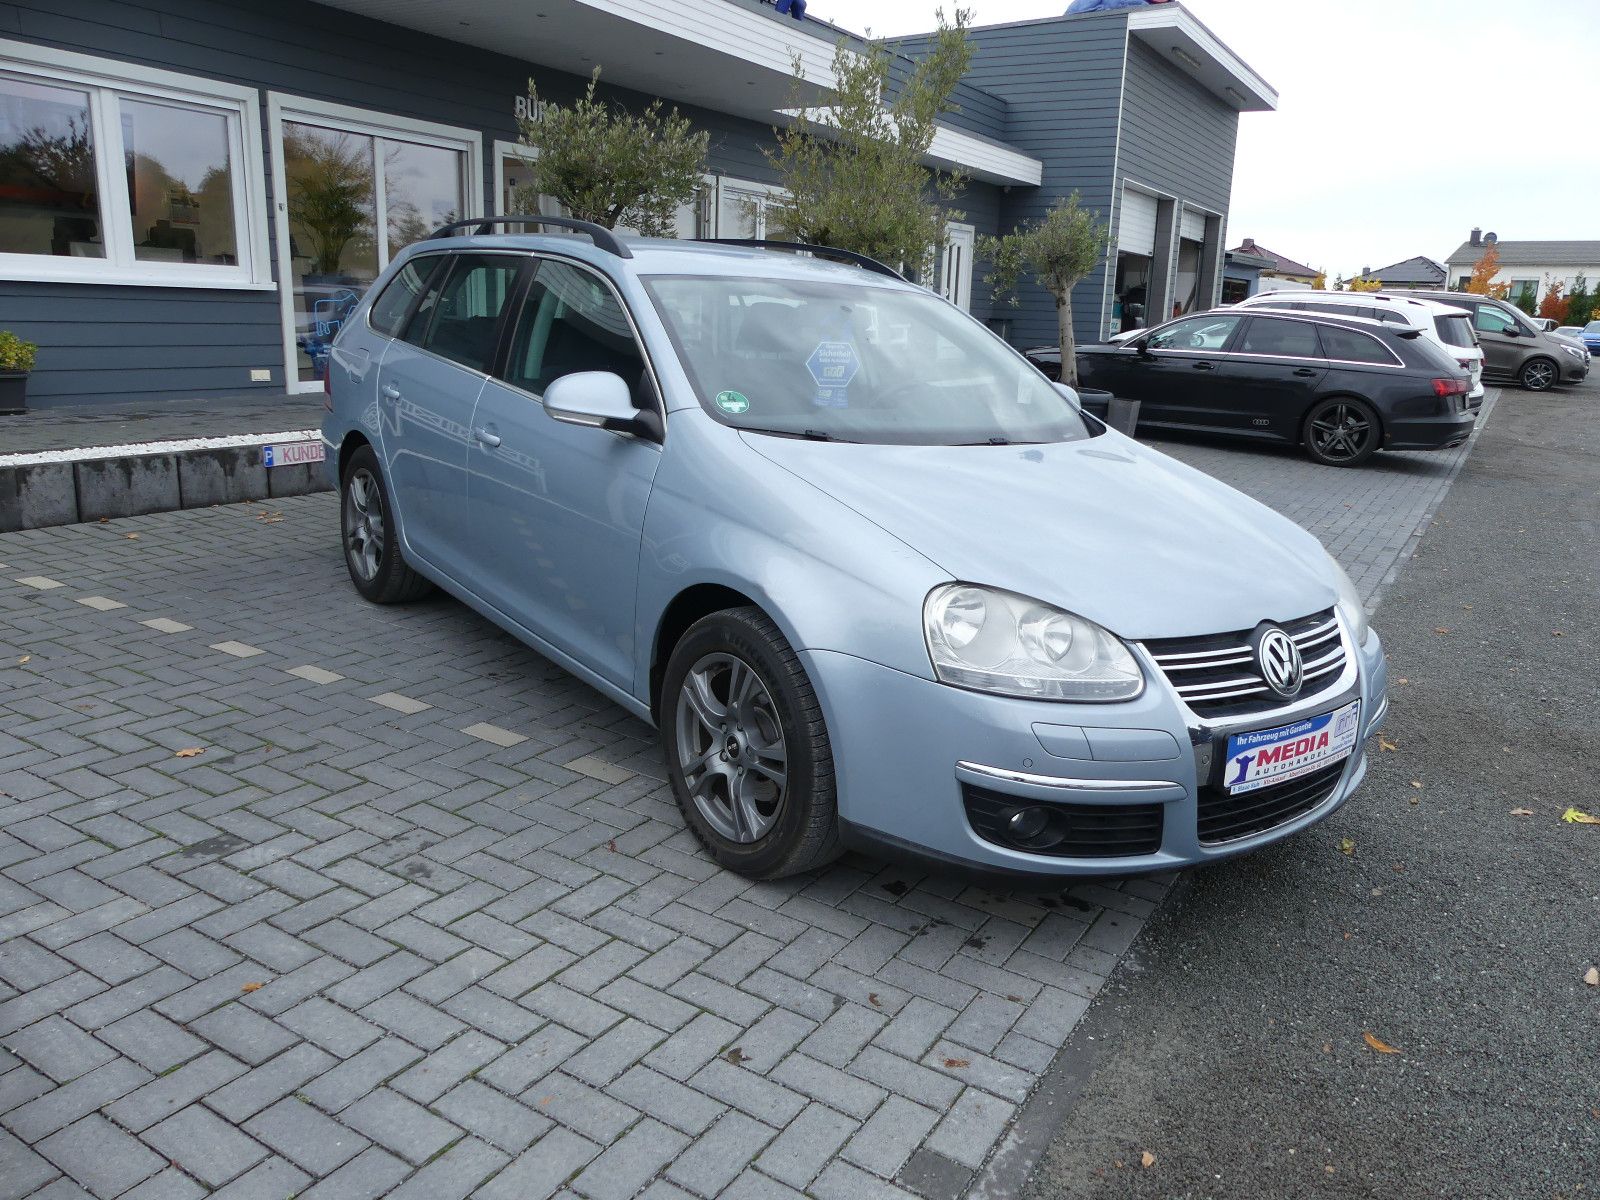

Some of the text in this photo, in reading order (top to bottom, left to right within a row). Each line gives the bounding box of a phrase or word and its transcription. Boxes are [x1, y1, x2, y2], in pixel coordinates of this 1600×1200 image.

[514, 95, 560, 123] BÜR
[265, 450, 273, 462] P
[1237, 721, 1312, 746] Ihr Fahrzeug mit Garantie
[1256, 731, 1329, 767] MEDIA
[1254, 750, 1327, 777] AUTOHANDEL
